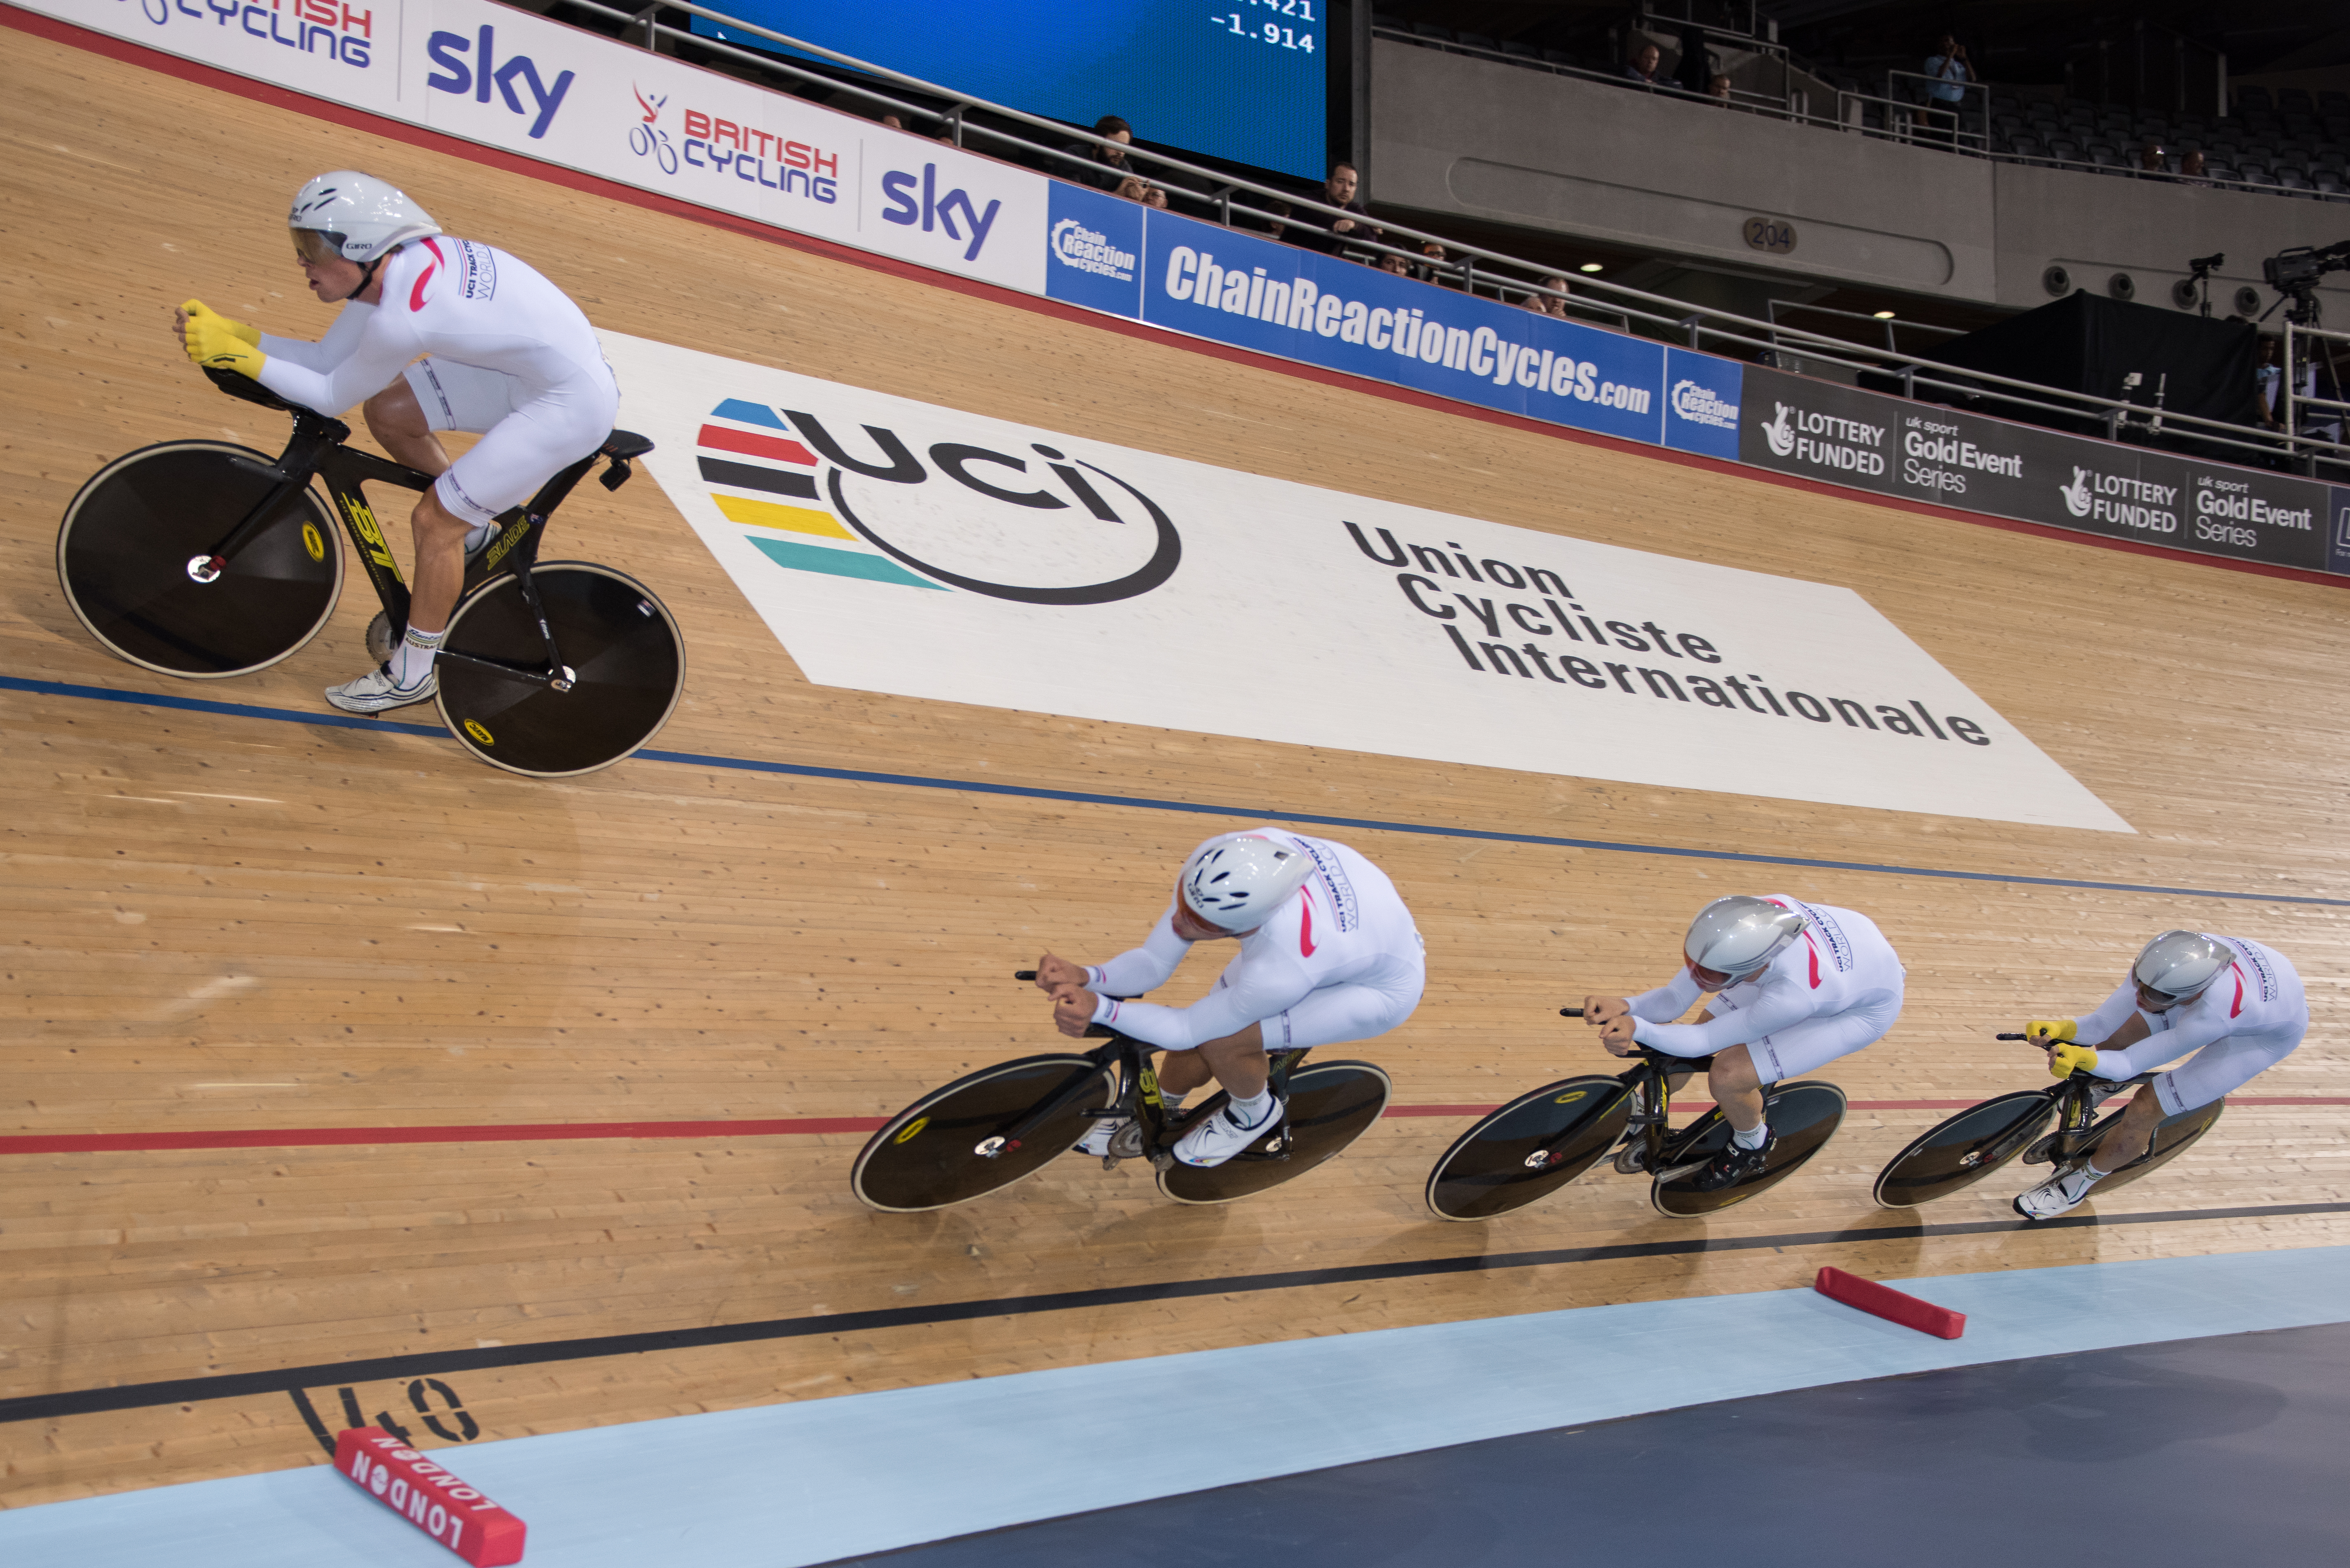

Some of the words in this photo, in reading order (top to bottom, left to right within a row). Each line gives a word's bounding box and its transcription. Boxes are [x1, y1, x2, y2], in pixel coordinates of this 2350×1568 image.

[1210, 13, 1315, 54] -1.914
[427, 24, 576, 139] sky
[683, 108, 838, 178] BRITISH
[683, 139, 838, 204] CYCLING
[882, 163, 1001, 262] sky
[1063, 233, 1135, 271] Reaction
[1753, 222, 1790, 248] 204
[467, 254, 477, 277] TRACK
[475, 251, 493, 299] WORLD
[466, 279, 476, 298] UCI
[1166, 246, 1651, 415] ChainReactionCycles.com
[1681, 392, 1739, 420] Reaction
[1798, 410, 1885, 447] LOTTERY
[1905, 416, 1922, 429] uk
[1924, 421, 1959, 437] sport
[1796, 437, 1885, 476] FUNDED
[1903, 458, 1966, 493] Series
[2094, 473, 2177, 506] LOTTERY
[2198, 476, 2214, 488] uk
[2215, 480, 2249, 494] sport
[2093, 498, 2177, 533] FUNDED
[2195, 515, 2257, 548] Series
[1343, 521, 1574, 598] Union
[1397, 572, 1723, 665] Cycliste
[1442, 624, 1991, 747] Internationale
[1324, 874, 1344, 909] TRACK
[1329, 865, 1356, 932] WORLD
[1821, 926, 1840, 955] TRACK
[1826, 921, 1851, 972] WORLD
[2250, 957, 2267, 984] TRACK
[2254, 952, 2276, 1001] WORLD
[371, 1437, 499, 1511] LONDON
[351, 1449, 463, 1550] LONDON
